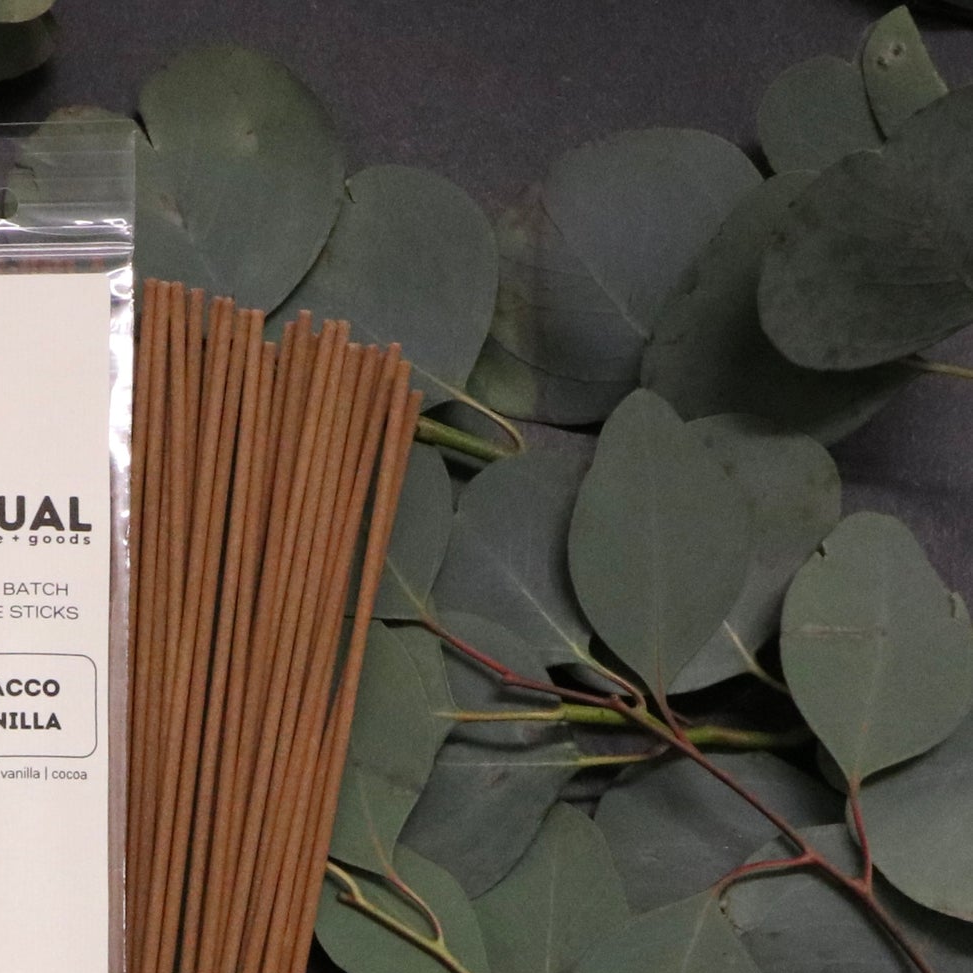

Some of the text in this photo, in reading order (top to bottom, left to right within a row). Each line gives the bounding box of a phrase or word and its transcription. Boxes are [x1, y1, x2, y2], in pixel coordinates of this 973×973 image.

[28, 533, 92, 547] goods
[3, 582, 69, 597] BATCH
[9, 605, 79, 620] STICKS
[0, 767, 41, 780] vanilla
[51, 770, 88, 781] cocoa
